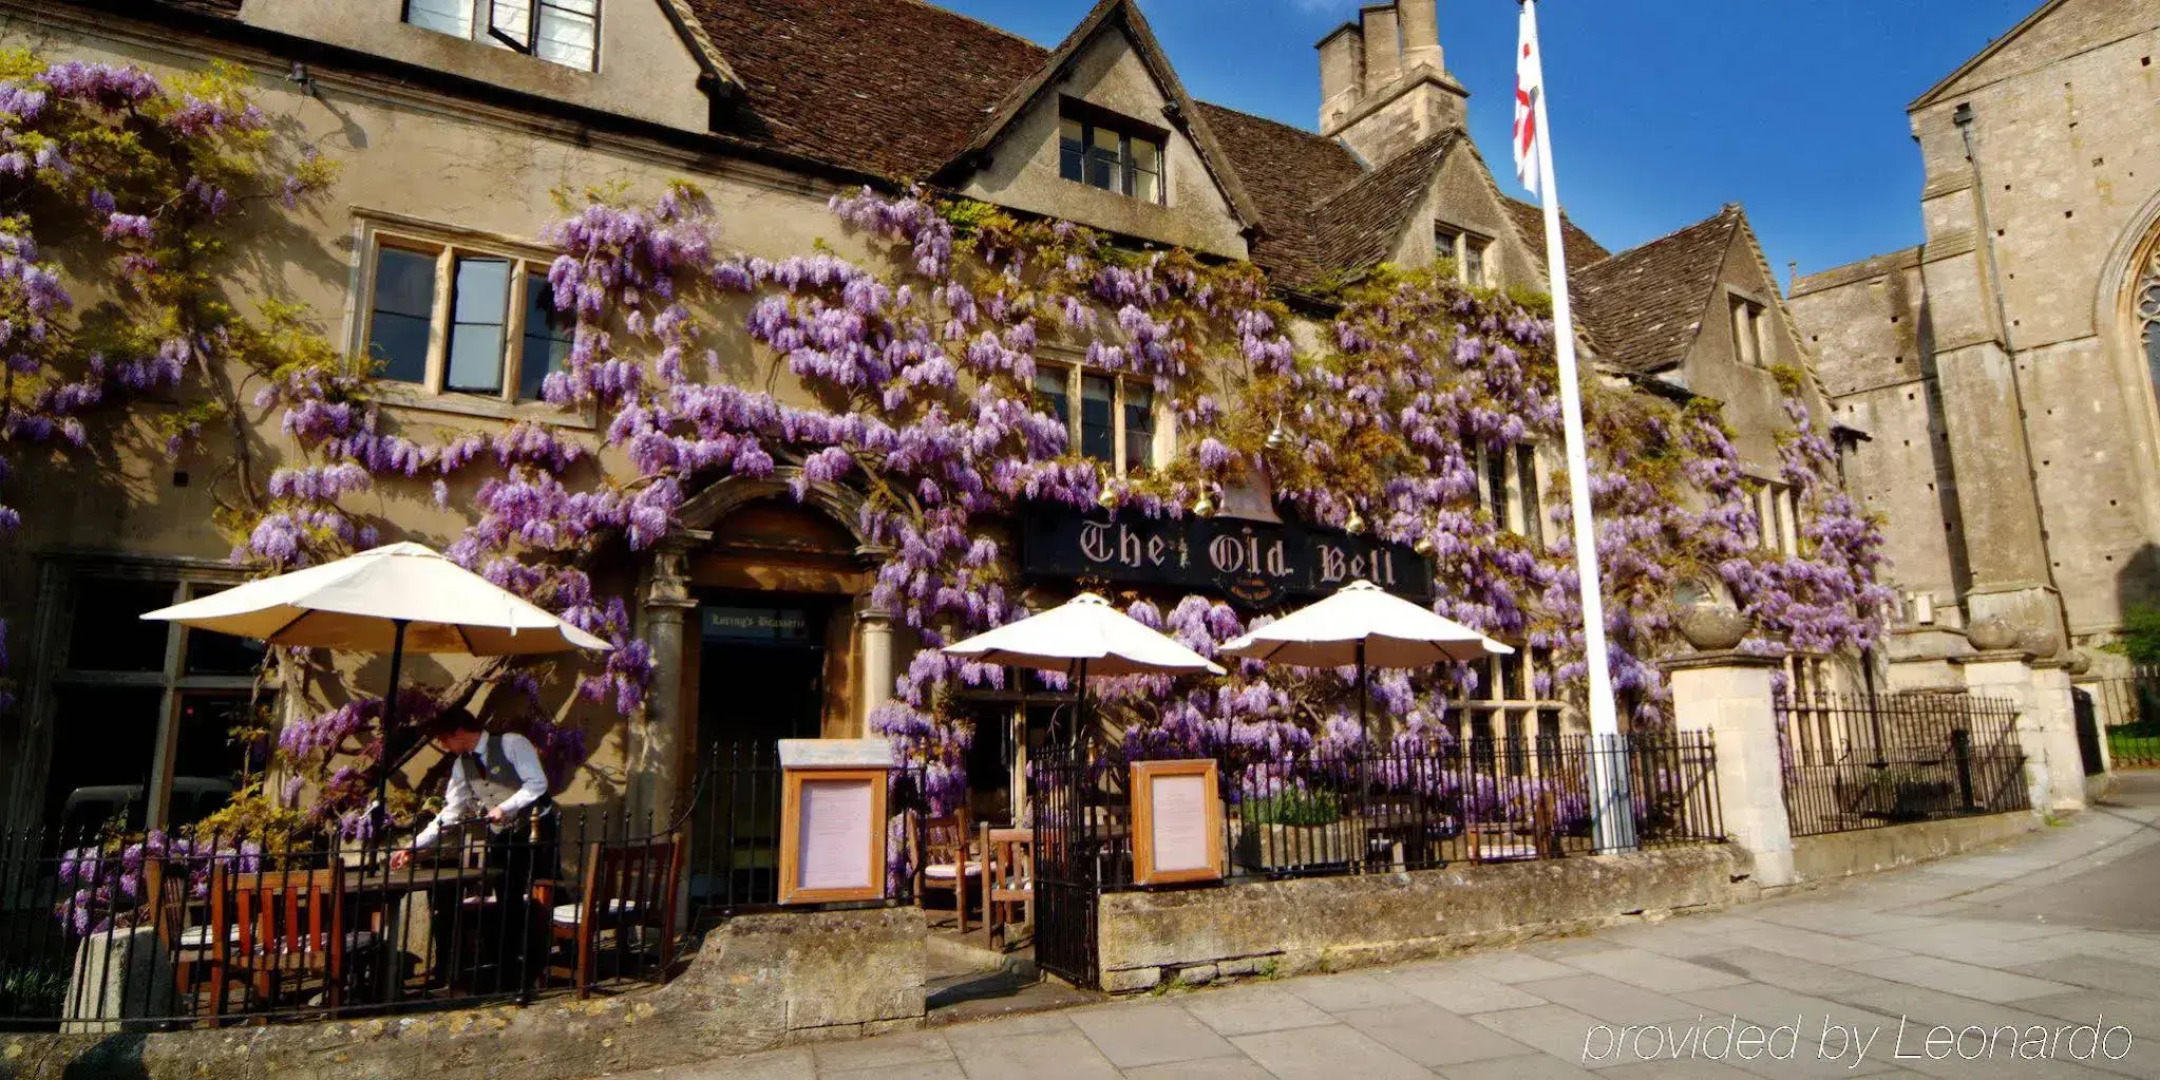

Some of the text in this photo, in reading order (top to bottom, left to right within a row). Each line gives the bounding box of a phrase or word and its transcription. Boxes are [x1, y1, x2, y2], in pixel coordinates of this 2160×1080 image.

[1079, 520, 1396, 585] The Old Bell
